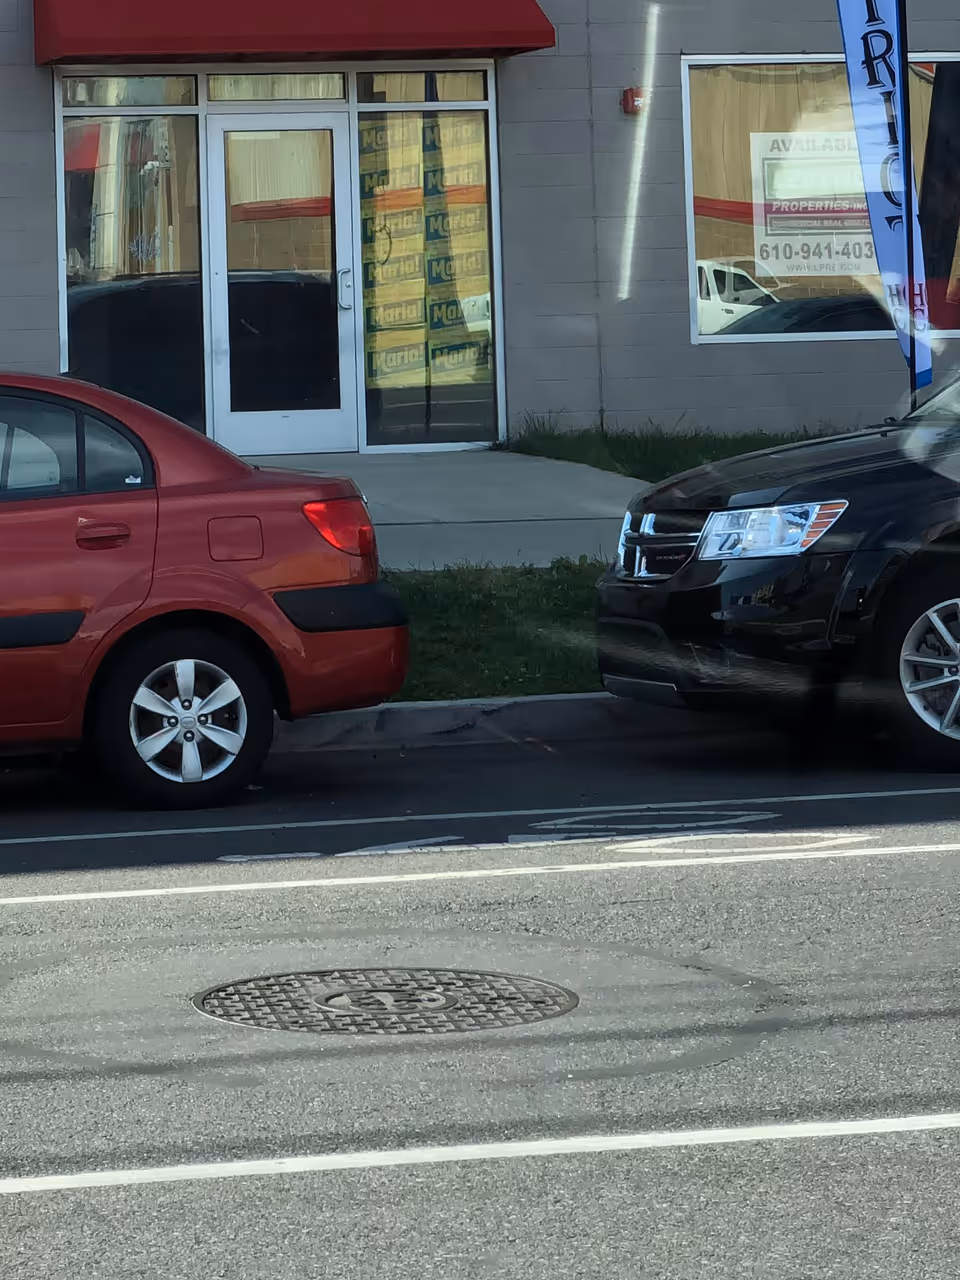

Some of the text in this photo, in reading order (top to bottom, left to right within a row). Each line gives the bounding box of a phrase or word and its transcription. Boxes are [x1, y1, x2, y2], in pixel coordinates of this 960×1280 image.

[769, 137, 858, 152] AVAILABL
[772, 200, 849, 211] PROPERTIES
[760, 241, 874, 260] 610-941-403
